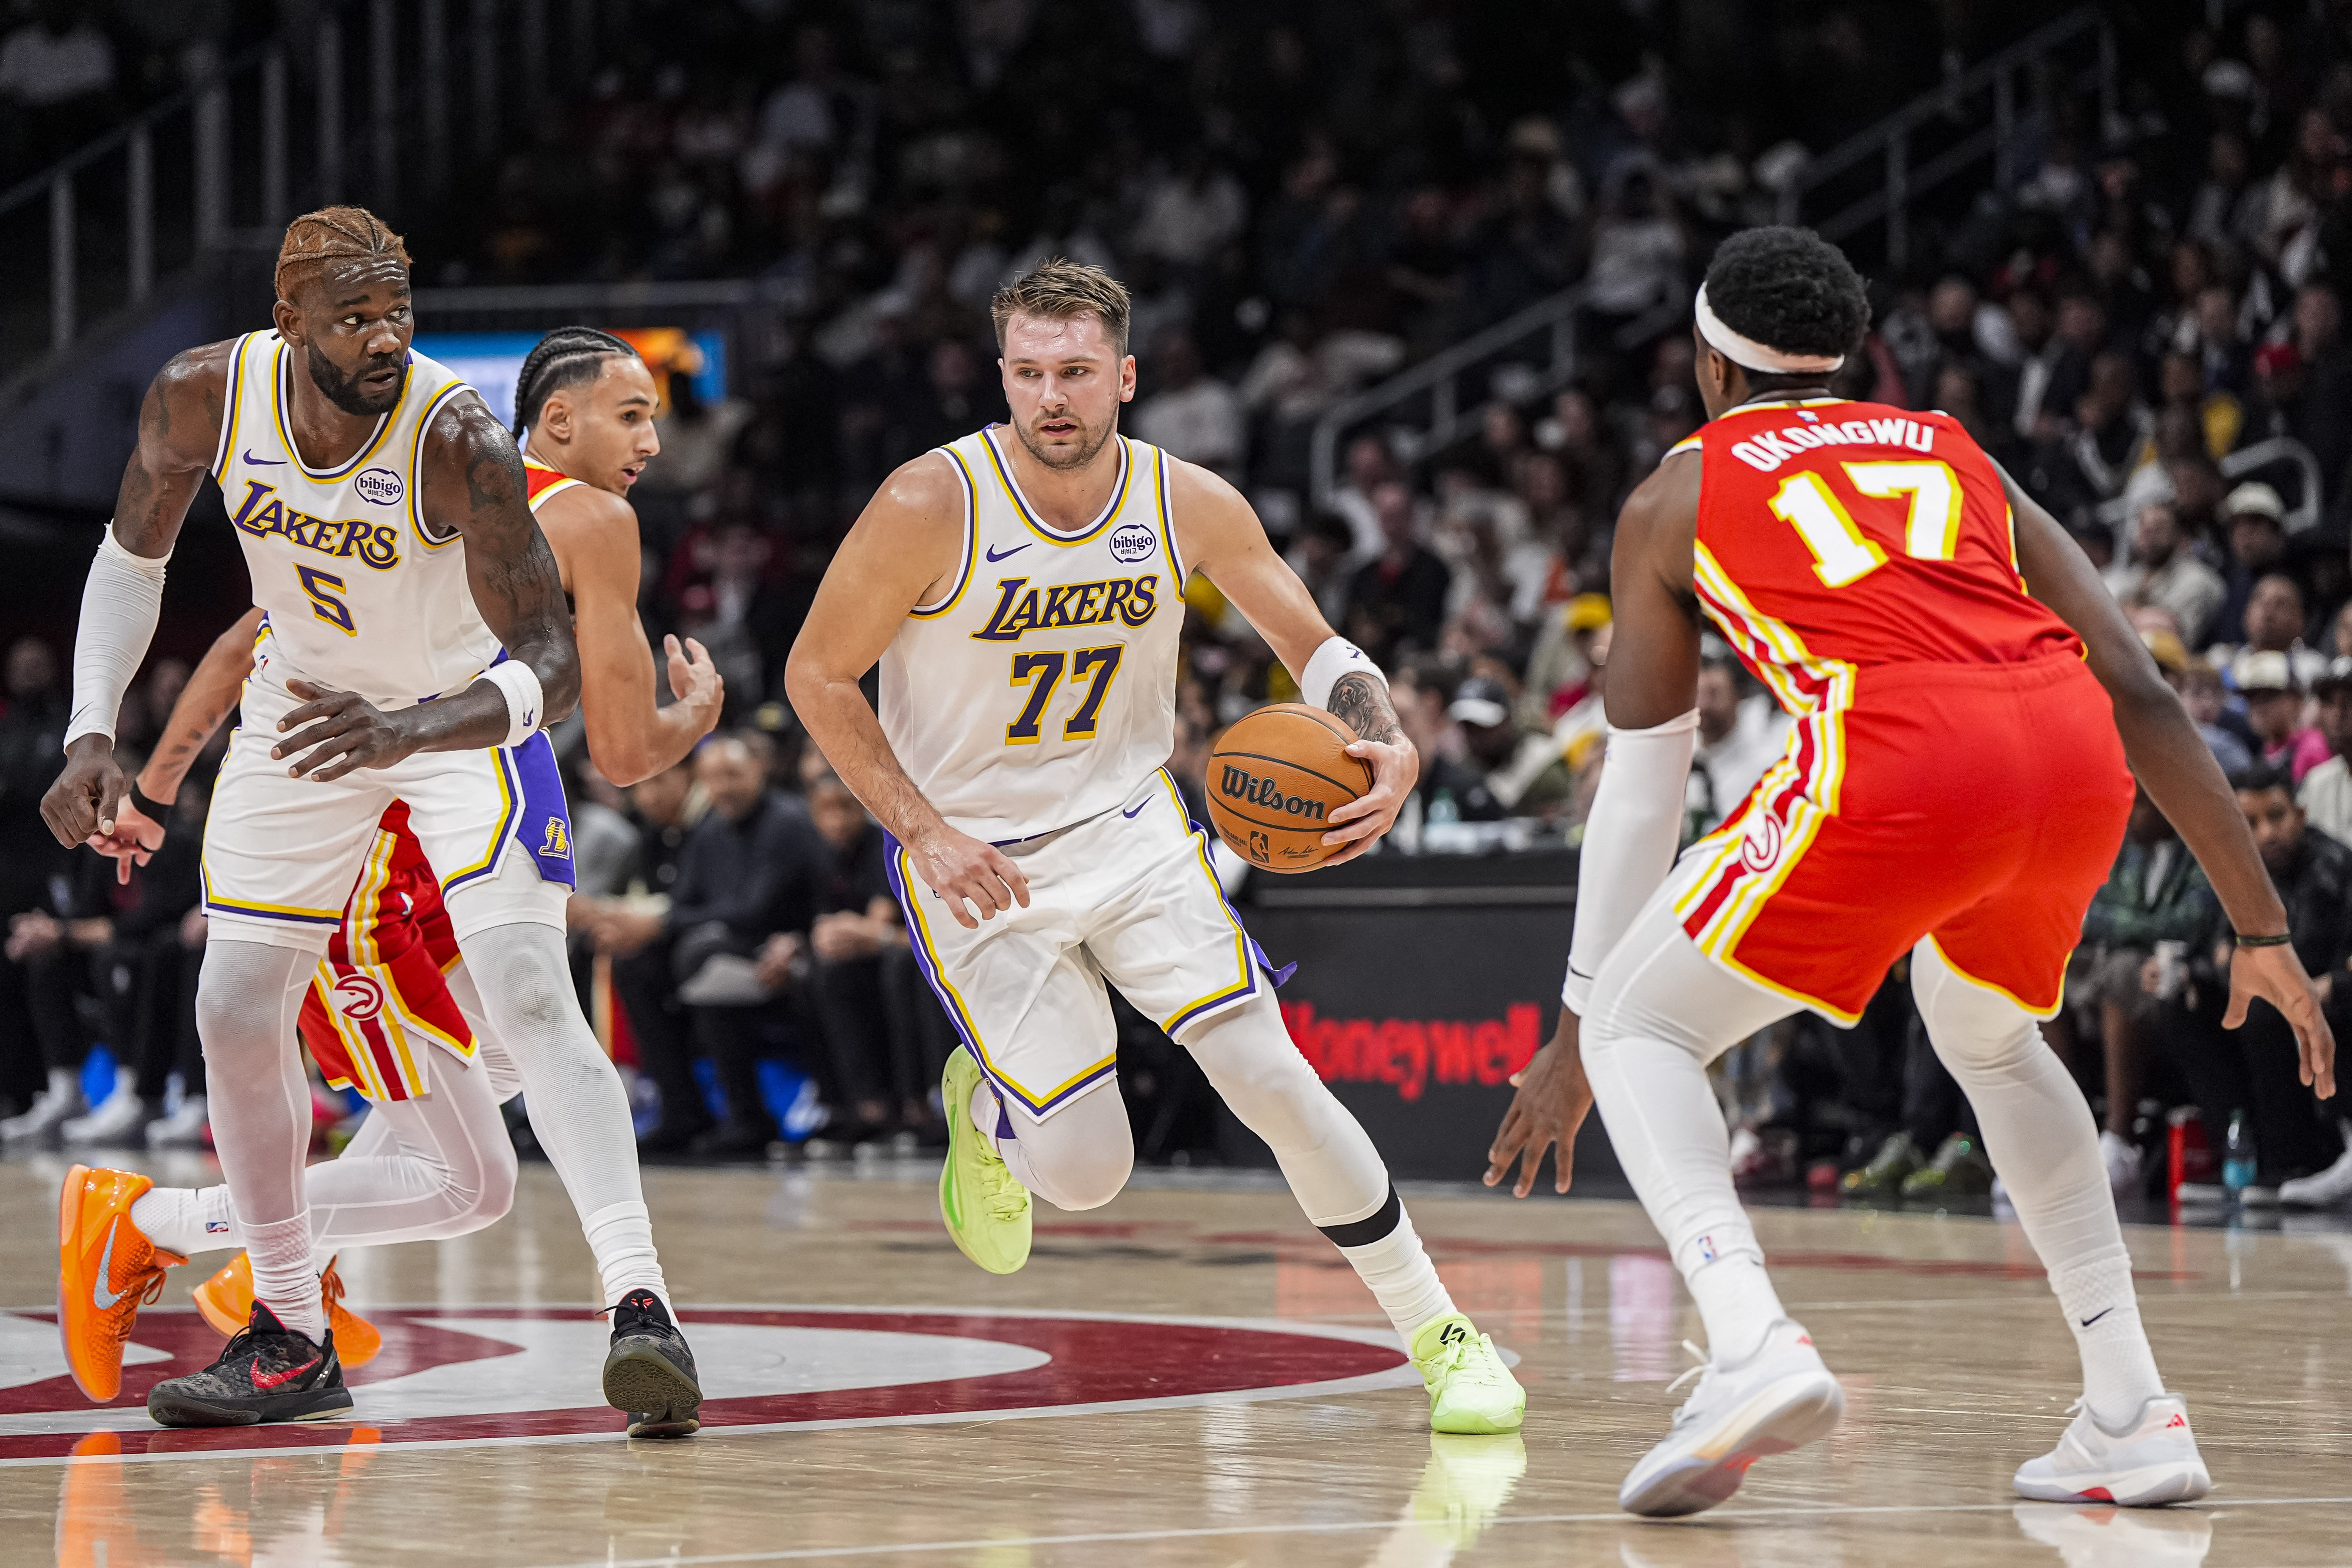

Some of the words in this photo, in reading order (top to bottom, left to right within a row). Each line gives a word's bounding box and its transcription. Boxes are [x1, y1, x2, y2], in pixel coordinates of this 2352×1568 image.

[1731, 418, 1934, 472] OKONGWU
[359, 477, 401, 496] bibigo
[368, 489, 384, 497] 비비고
[231, 478, 401, 572] LAKERS
[1114, 534, 1153, 550] bibigo
[1767, 460, 1964, 589] 17
[292, 562, 357, 637] 5
[969, 574, 1160, 642] LAKERS
[1005, 644, 1125, 745] 77
[1221, 763, 1325, 821] Wilson
